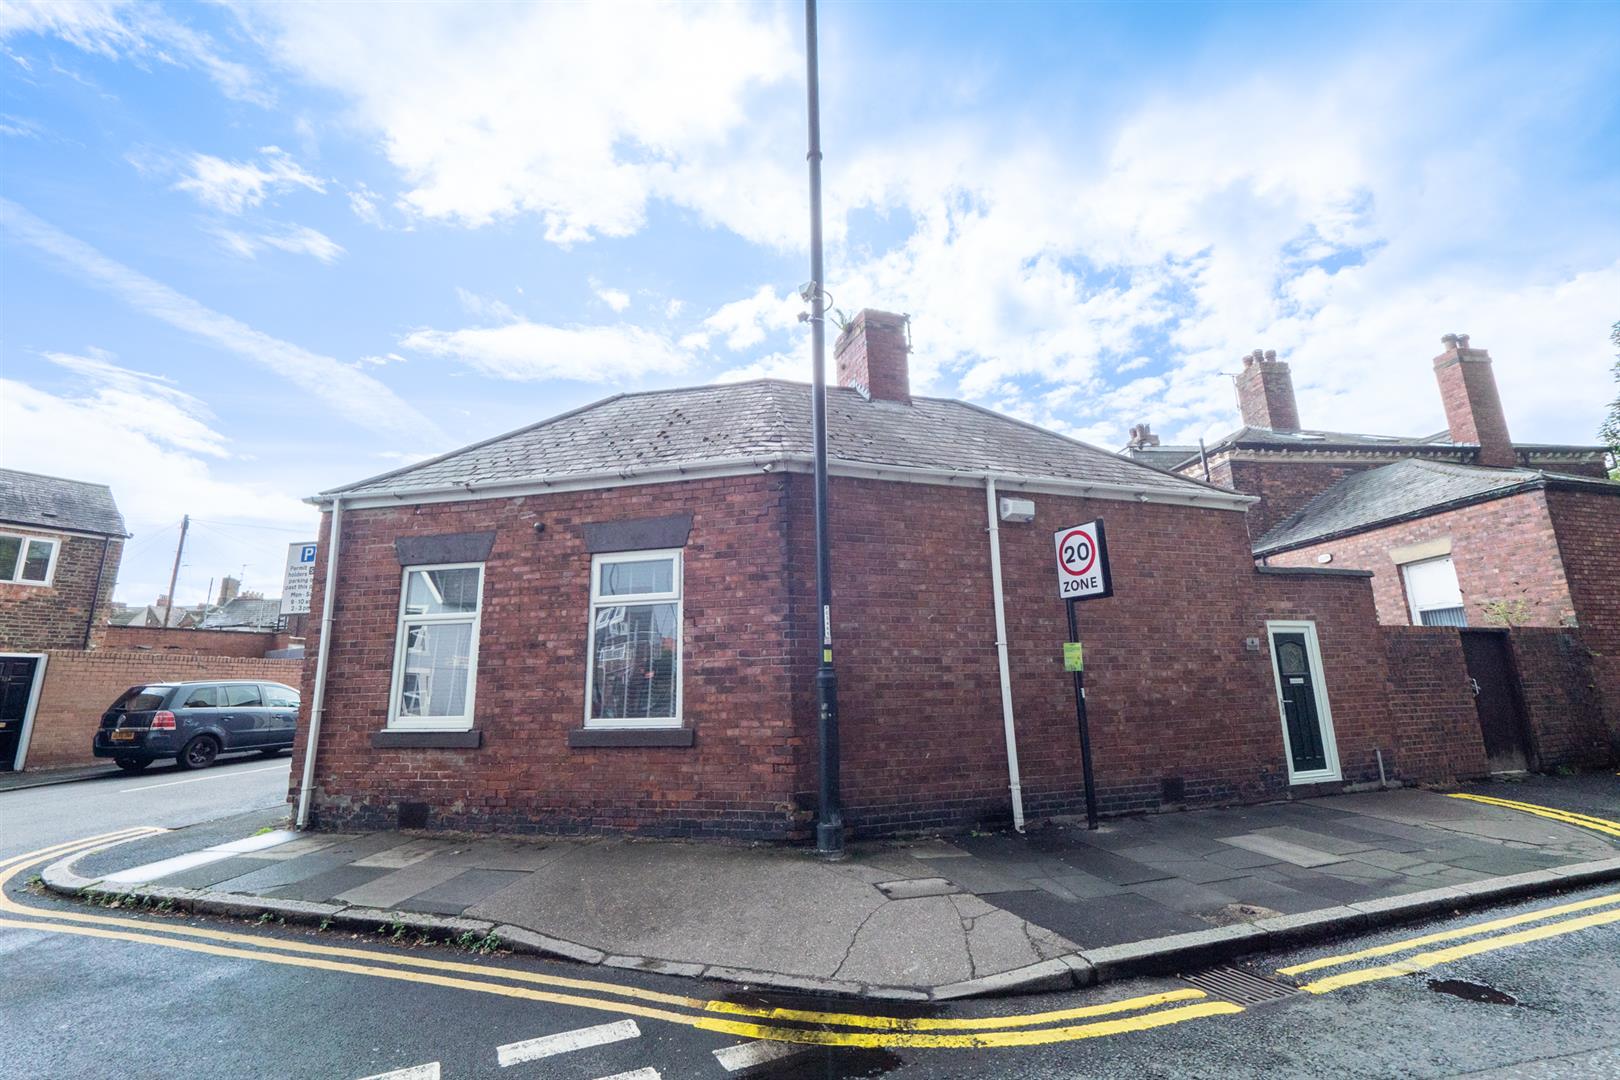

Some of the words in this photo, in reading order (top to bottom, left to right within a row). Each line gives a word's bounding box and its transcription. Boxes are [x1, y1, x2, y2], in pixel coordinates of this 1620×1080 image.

[304, 548, 314, 561] P
[1064, 542, 1090, 564] 20
[1063, 576, 1098, 592] ZONE
